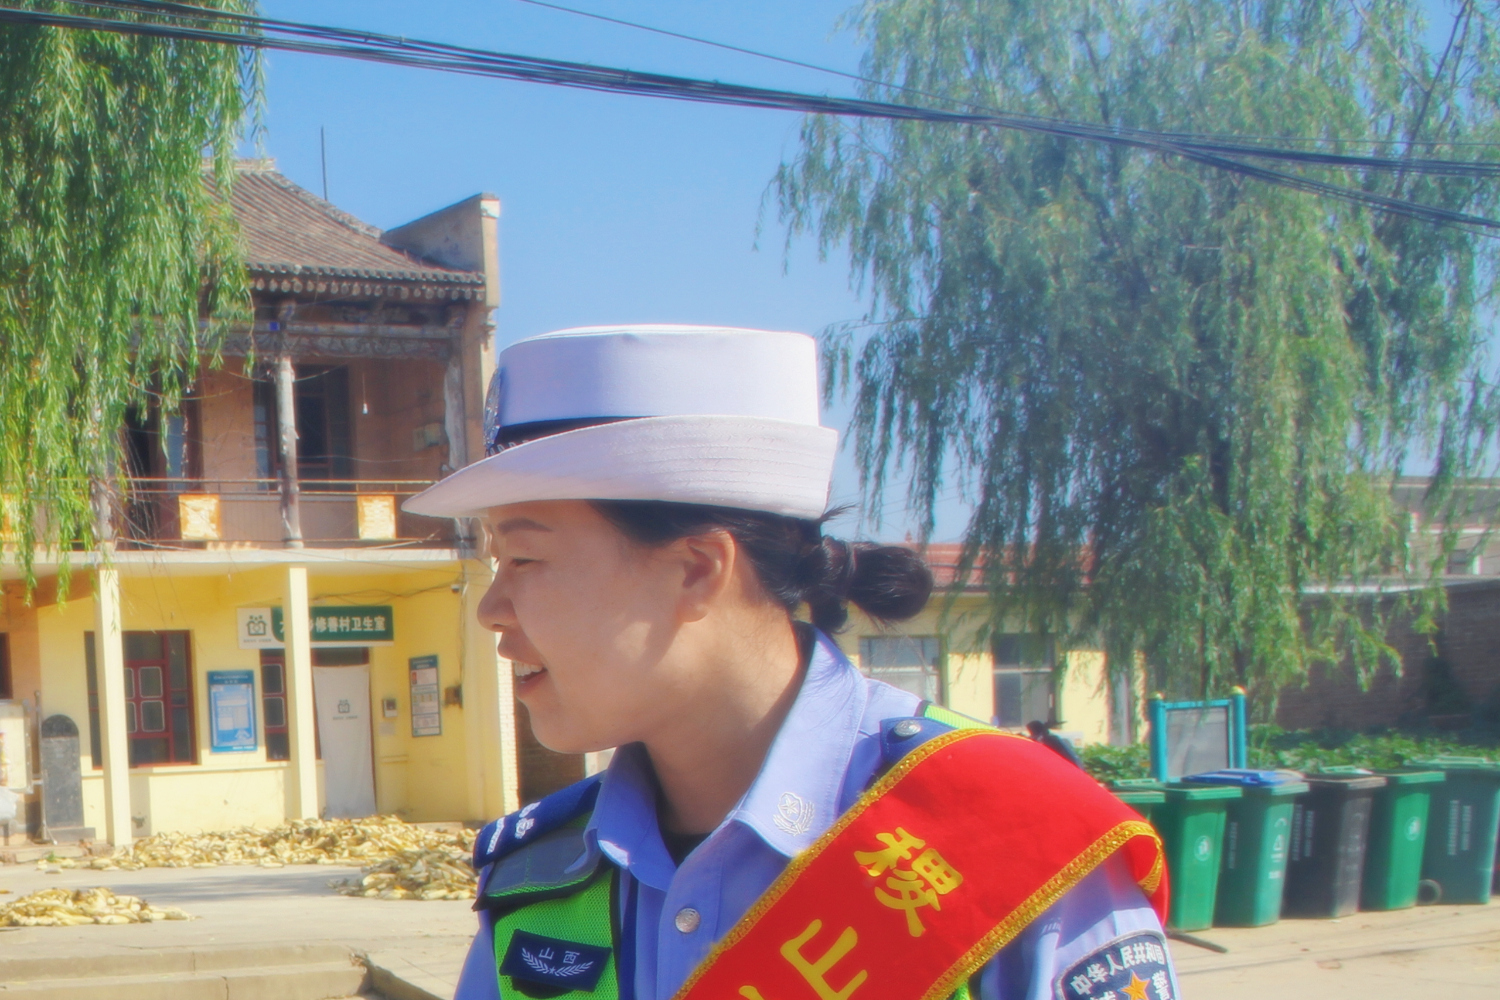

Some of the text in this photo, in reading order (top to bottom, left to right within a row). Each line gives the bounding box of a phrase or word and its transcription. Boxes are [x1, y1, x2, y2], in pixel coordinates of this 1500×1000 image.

[280, 616, 386, 633] 修善村卫生室
[539, 947, 581, 964] 山西
[1070, 942, 1166, 995] 中华人民共和国
